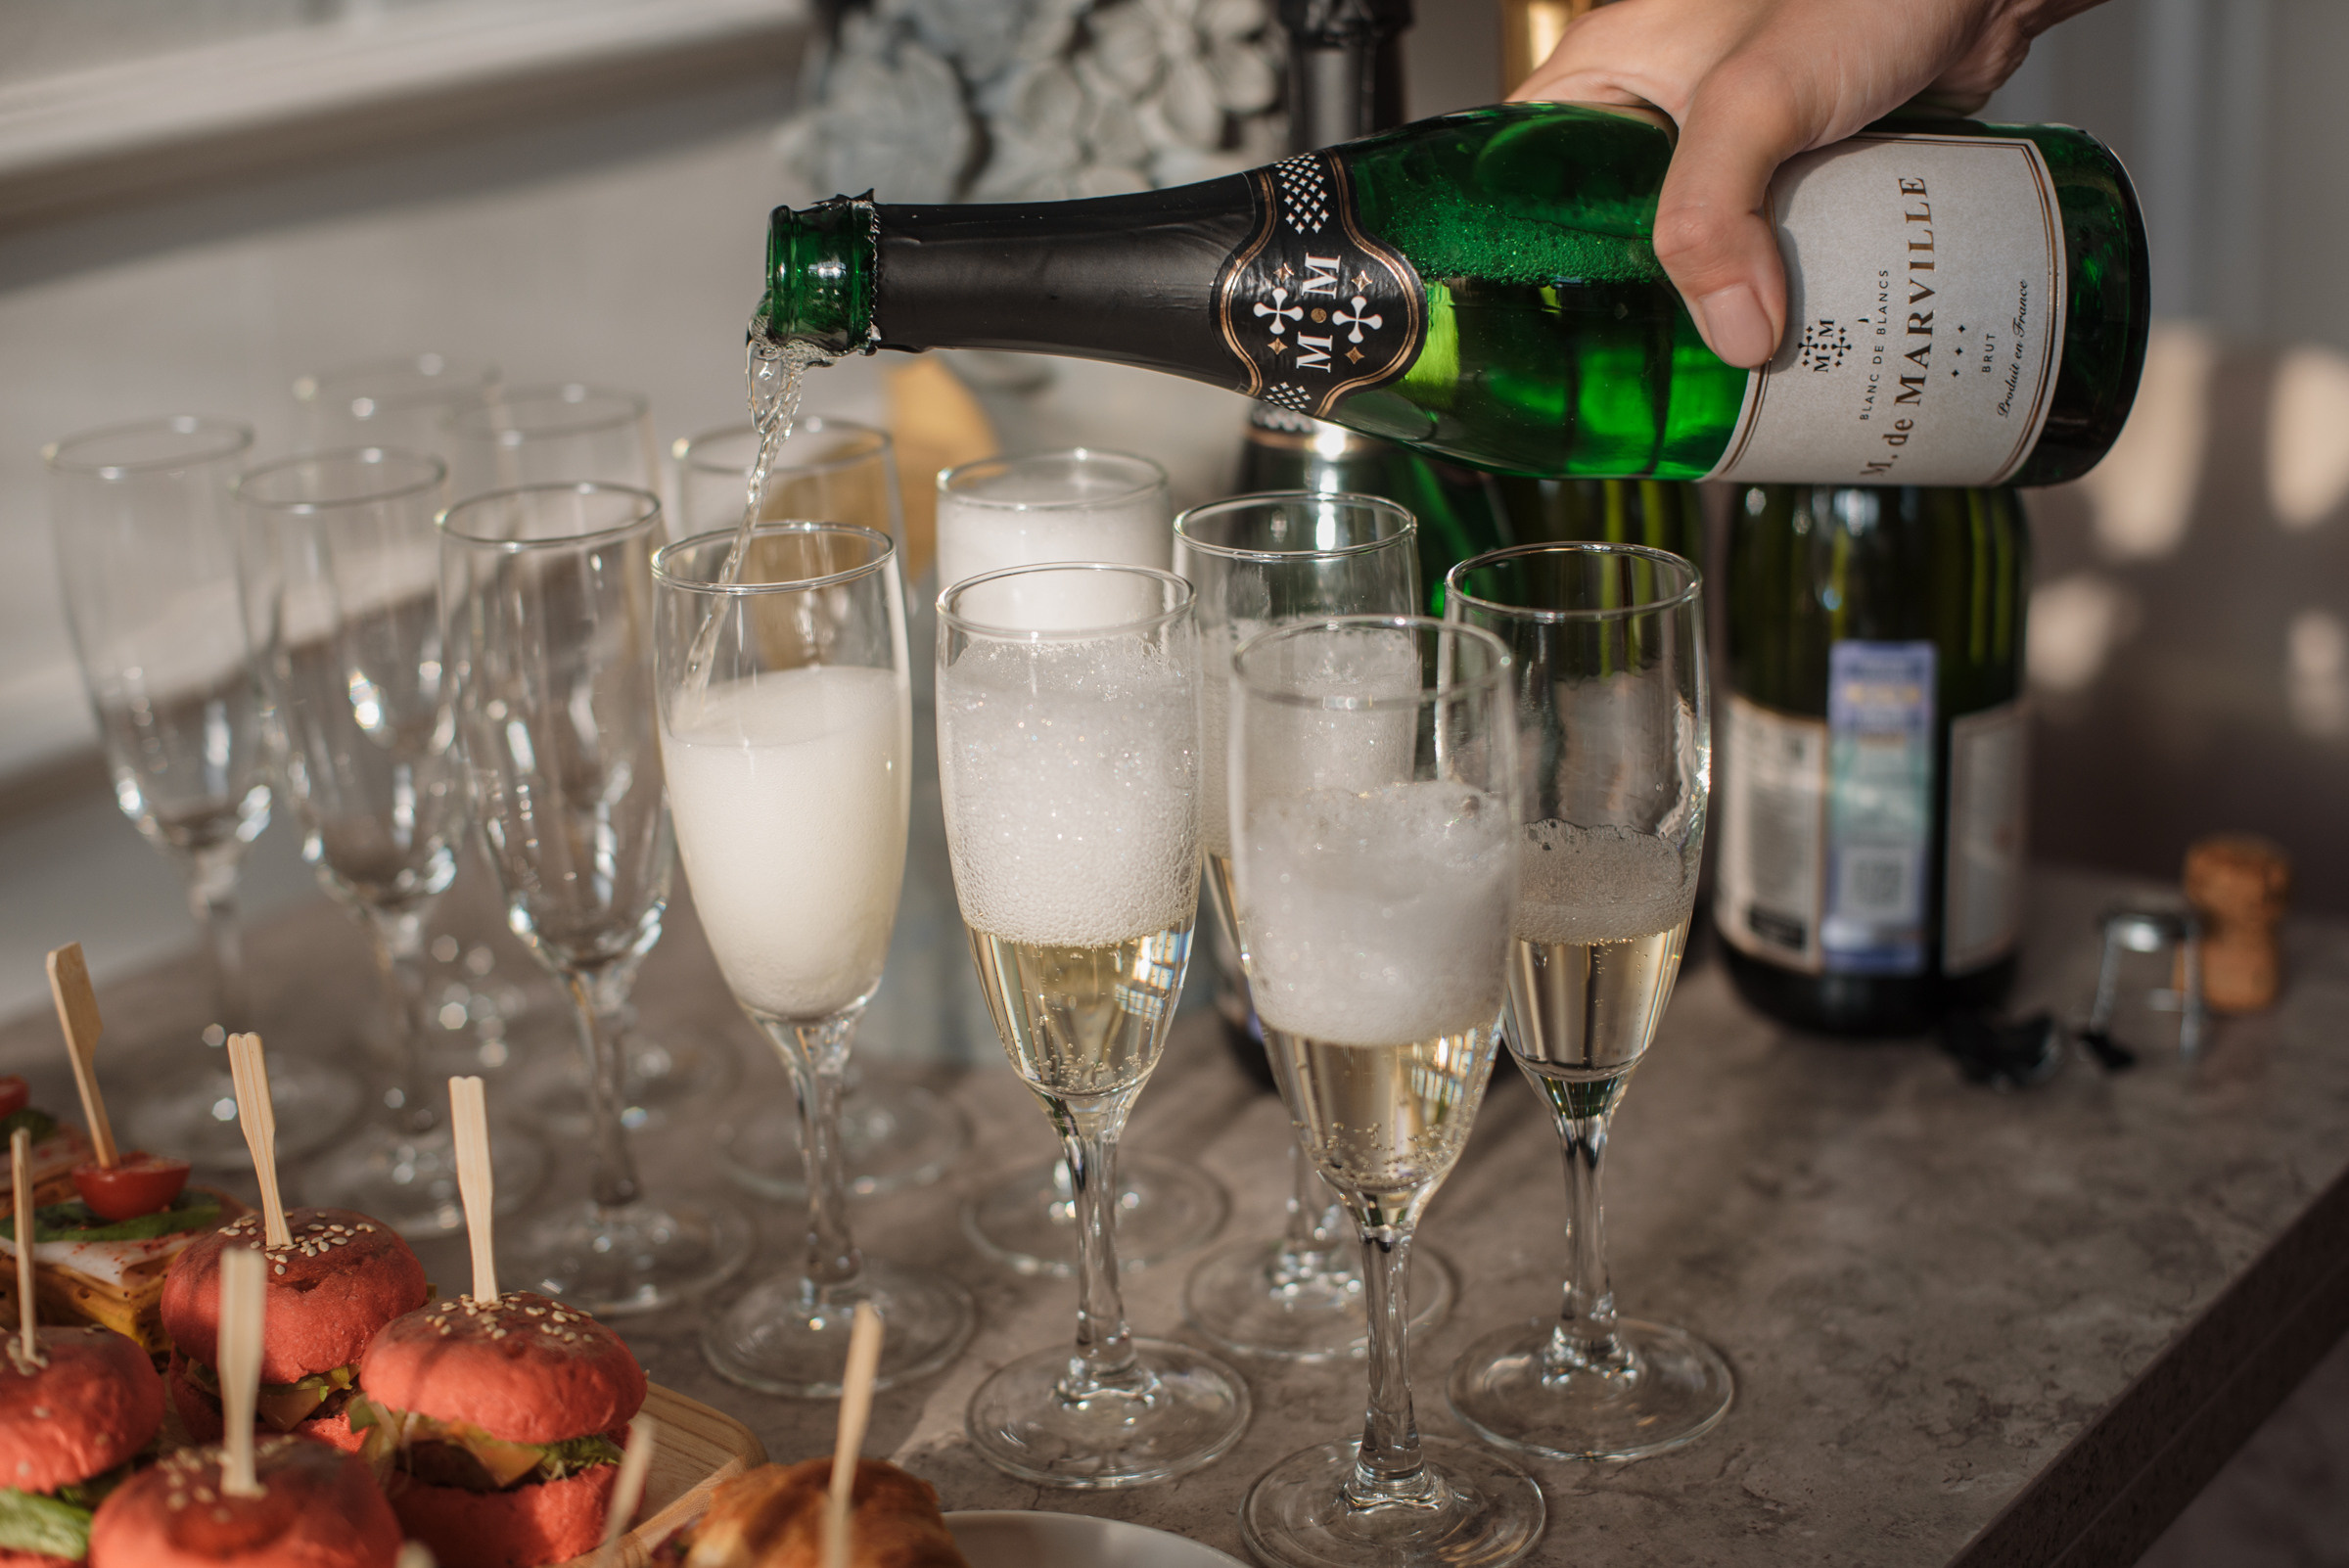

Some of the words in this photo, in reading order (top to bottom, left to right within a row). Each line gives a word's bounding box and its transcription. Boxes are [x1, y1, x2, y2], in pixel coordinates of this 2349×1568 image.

[1876, 269, 1889, 335] BLANCS
[1893, 176, 1936, 406] MARVILLE
[2012, 279, 2028, 339] France
[1872, 345, 1884, 364] DE
[1981, 333, 1996, 373] BRUT
[2014, 341, 2024, 359] en
[1860, 373, 1879, 420] BLANC
[1997, 362, 2020, 419] Produit
[1882, 418, 1914, 446] de
